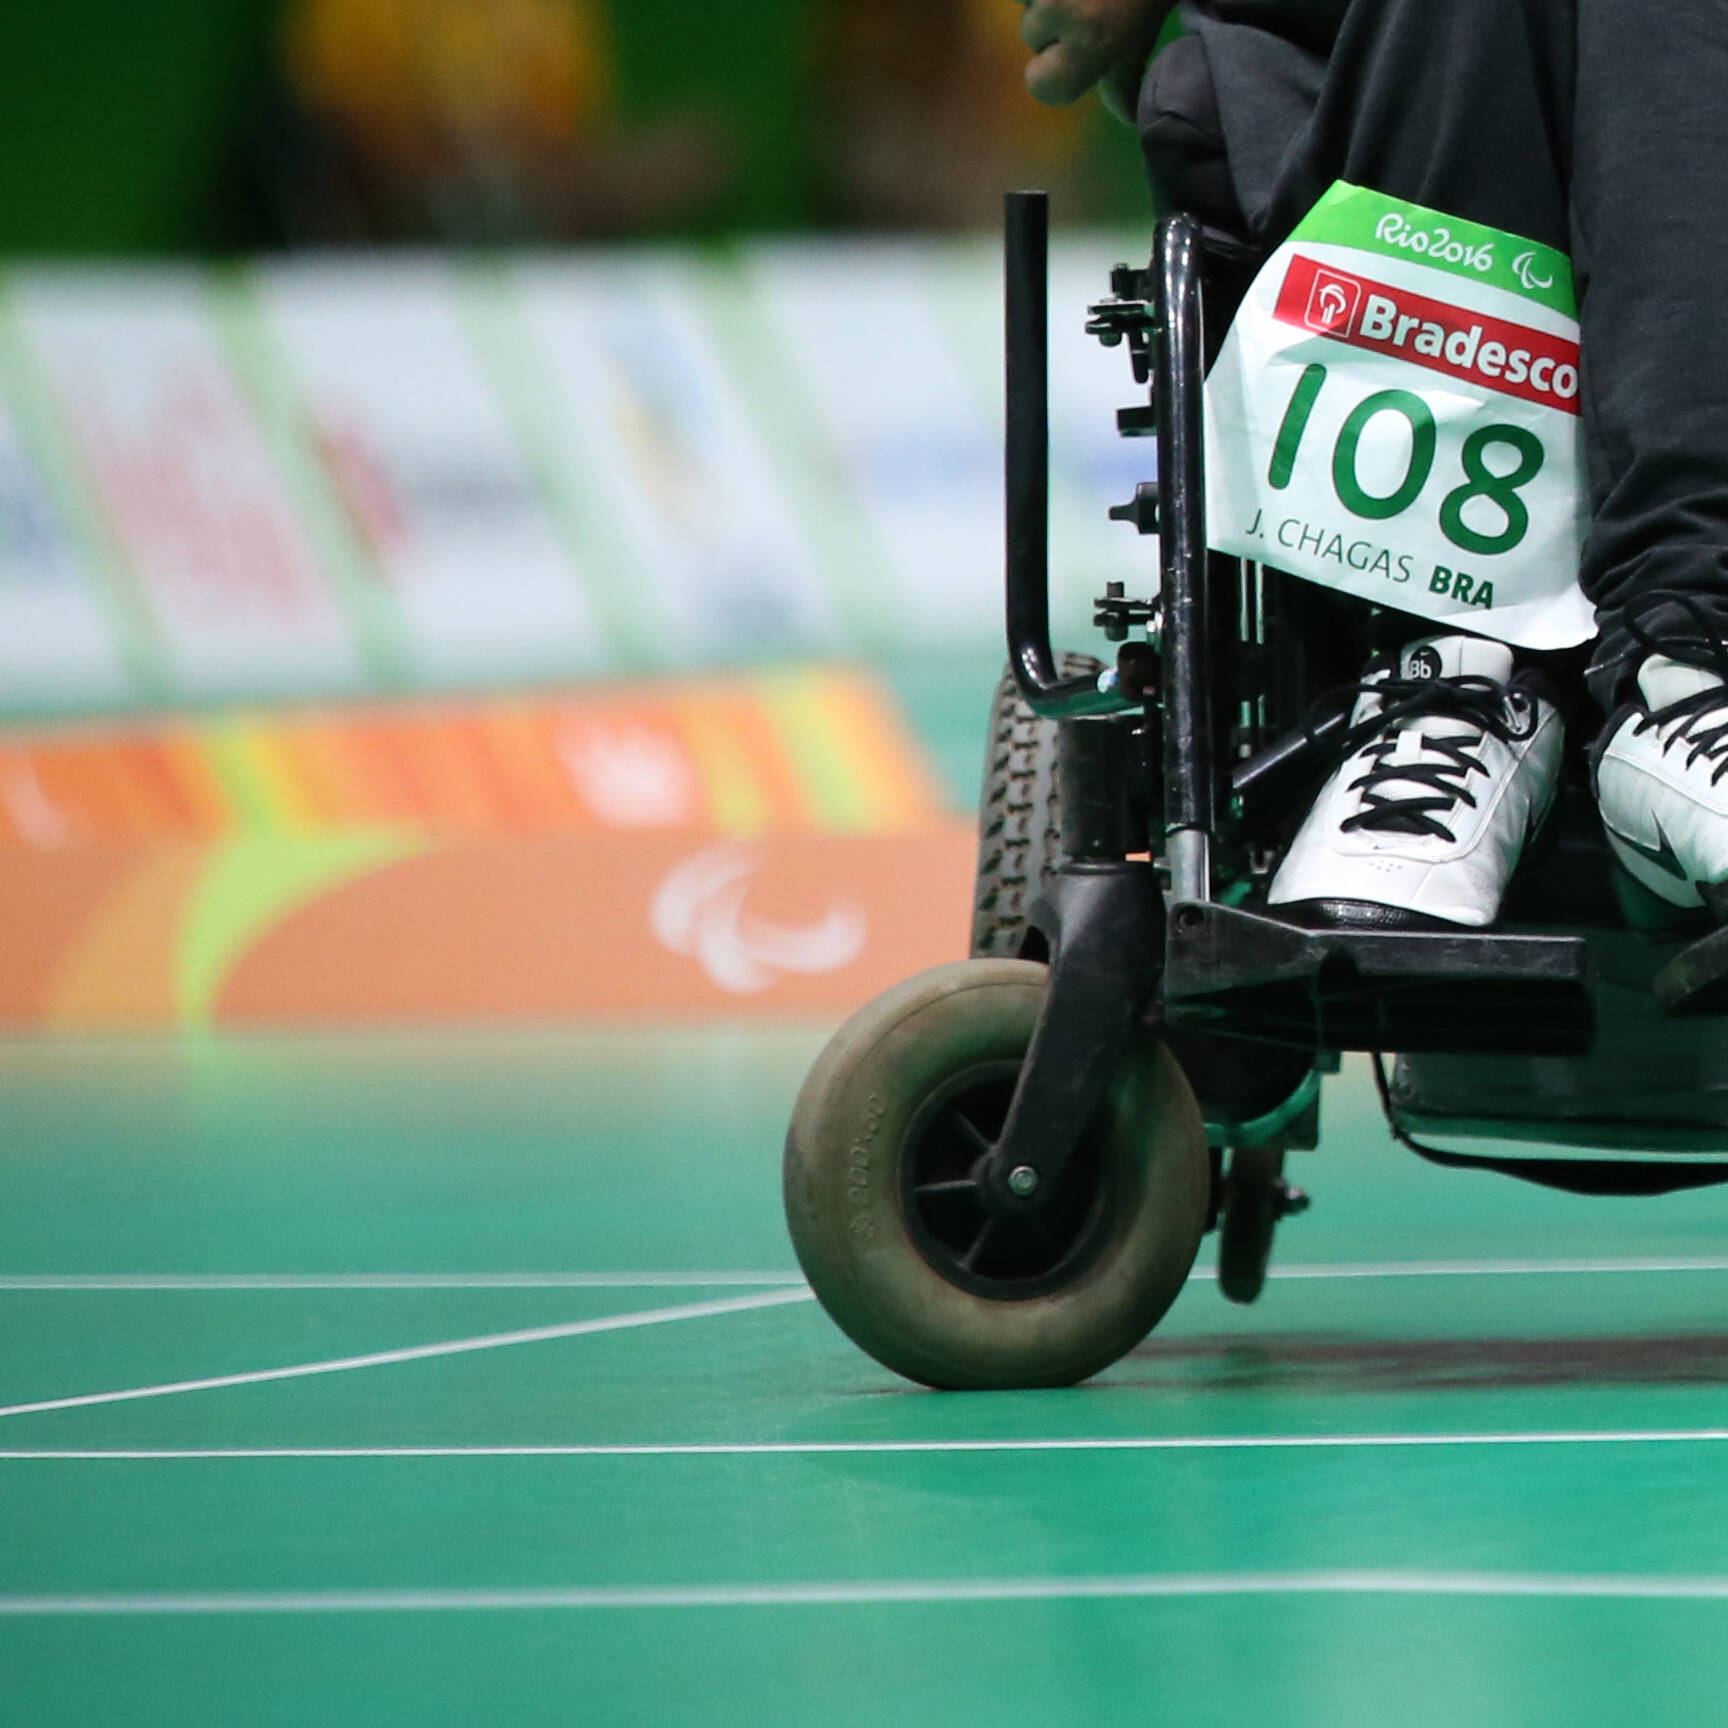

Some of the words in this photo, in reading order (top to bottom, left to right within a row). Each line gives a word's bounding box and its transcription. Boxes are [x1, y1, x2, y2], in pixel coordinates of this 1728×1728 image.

[1375, 212, 1494, 272] Rio2016
[1359, 294, 1580, 400] Bradesco
[1267, 362, 1545, 556] 108
[1245, 508, 1265, 540] J.
[1276, 518, 1414, 584] CHAGAS
[1428, 564, 1495, 611] BRA
